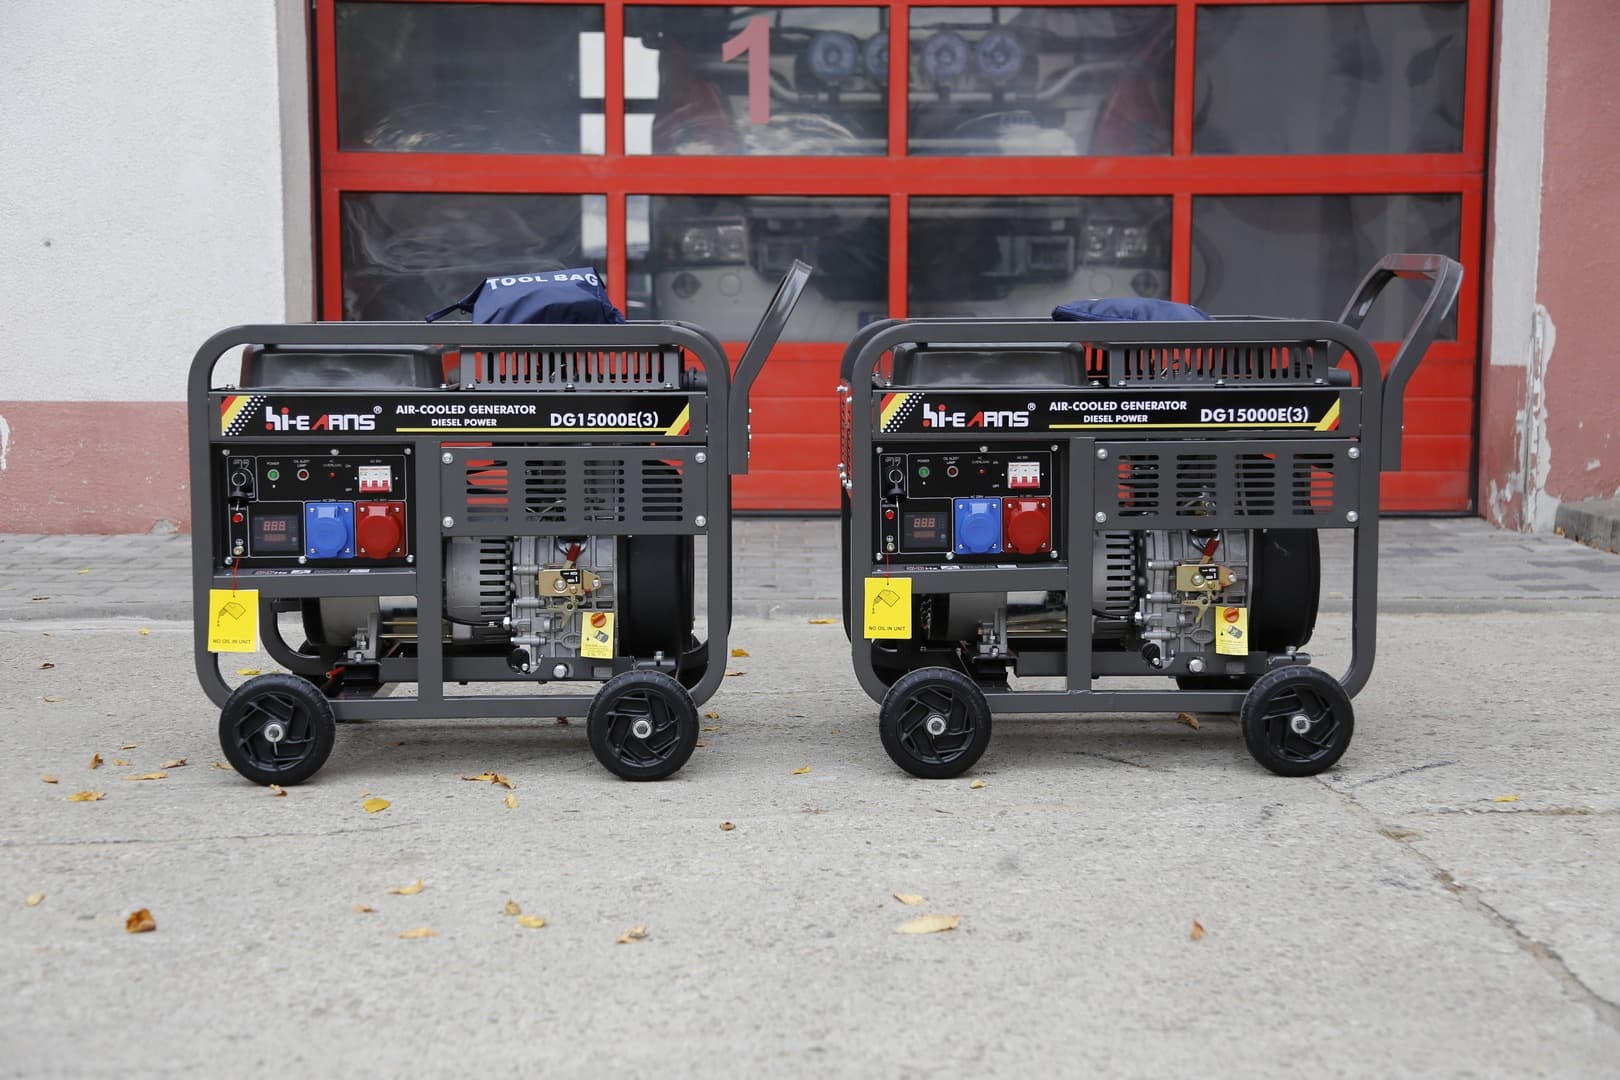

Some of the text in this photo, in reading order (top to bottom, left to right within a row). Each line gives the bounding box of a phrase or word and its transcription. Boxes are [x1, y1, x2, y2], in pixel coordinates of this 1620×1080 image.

[721, 16, 770, 125] 1
[486, 273, 600, 290] TOOL BAG
[396, 404, 537, 415] AIR-COOLED GENERATOR
[1049, 401, 1188, 412] AIR-COOLED GENERATOR
[549, 411, 659, 428] DG15000E(3)
[1083, 414, 1148, 423] DIESEL POWER
[1200, 406, 1309, 423] DG15000E(3)
[431, 418, 498, 427] DIESEL POWER
